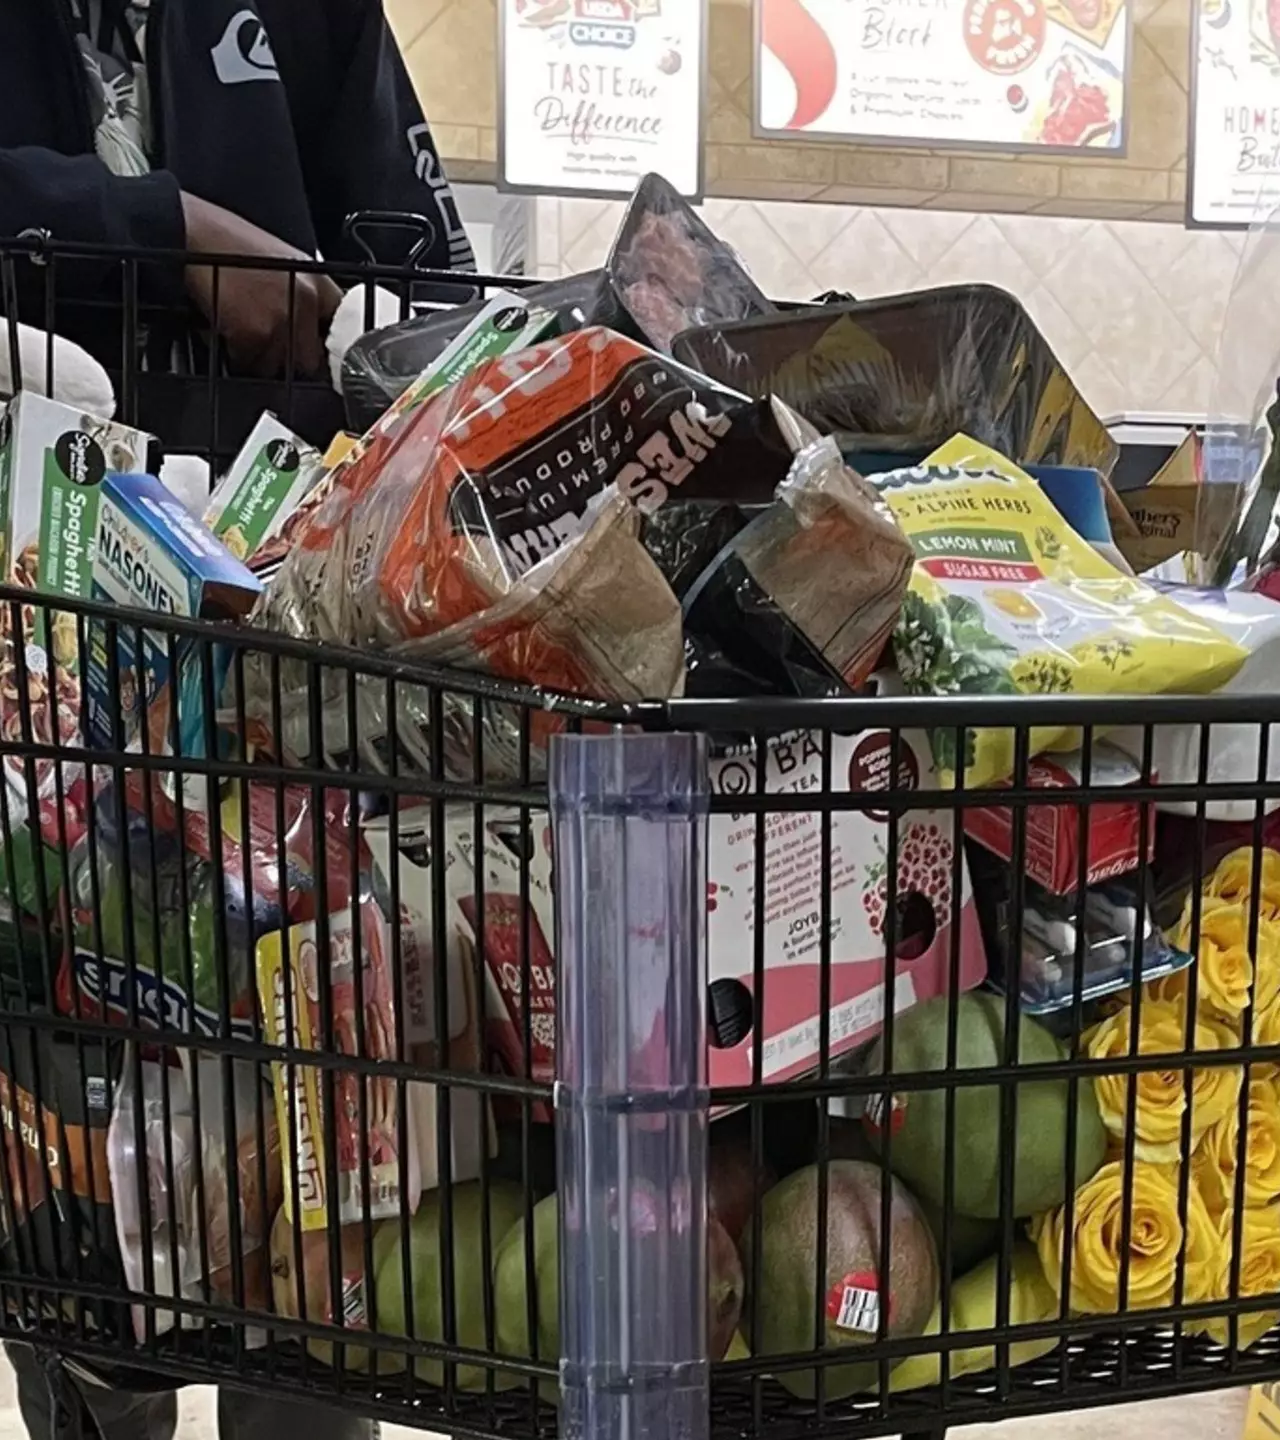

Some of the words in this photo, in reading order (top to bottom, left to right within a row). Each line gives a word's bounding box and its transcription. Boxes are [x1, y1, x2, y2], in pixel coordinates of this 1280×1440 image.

[546, 61, 623, 98] TASTE
[628, 77, 658, 99] the
[534, 96, 663, 145] Difference
[916, 498, 980, 516] ALPINE
[983, 498, 1033, 516] HERBS
[62, 488, 87, 597] Spaghetti
[918, 535, 978, 552] LEMON
[984, 536, 1017, 554] MINT
[943, 562, 988, 579] SUGAR
[990, 564, 1025, 581] FREE
[788, 911, 820, 936] JOYB
